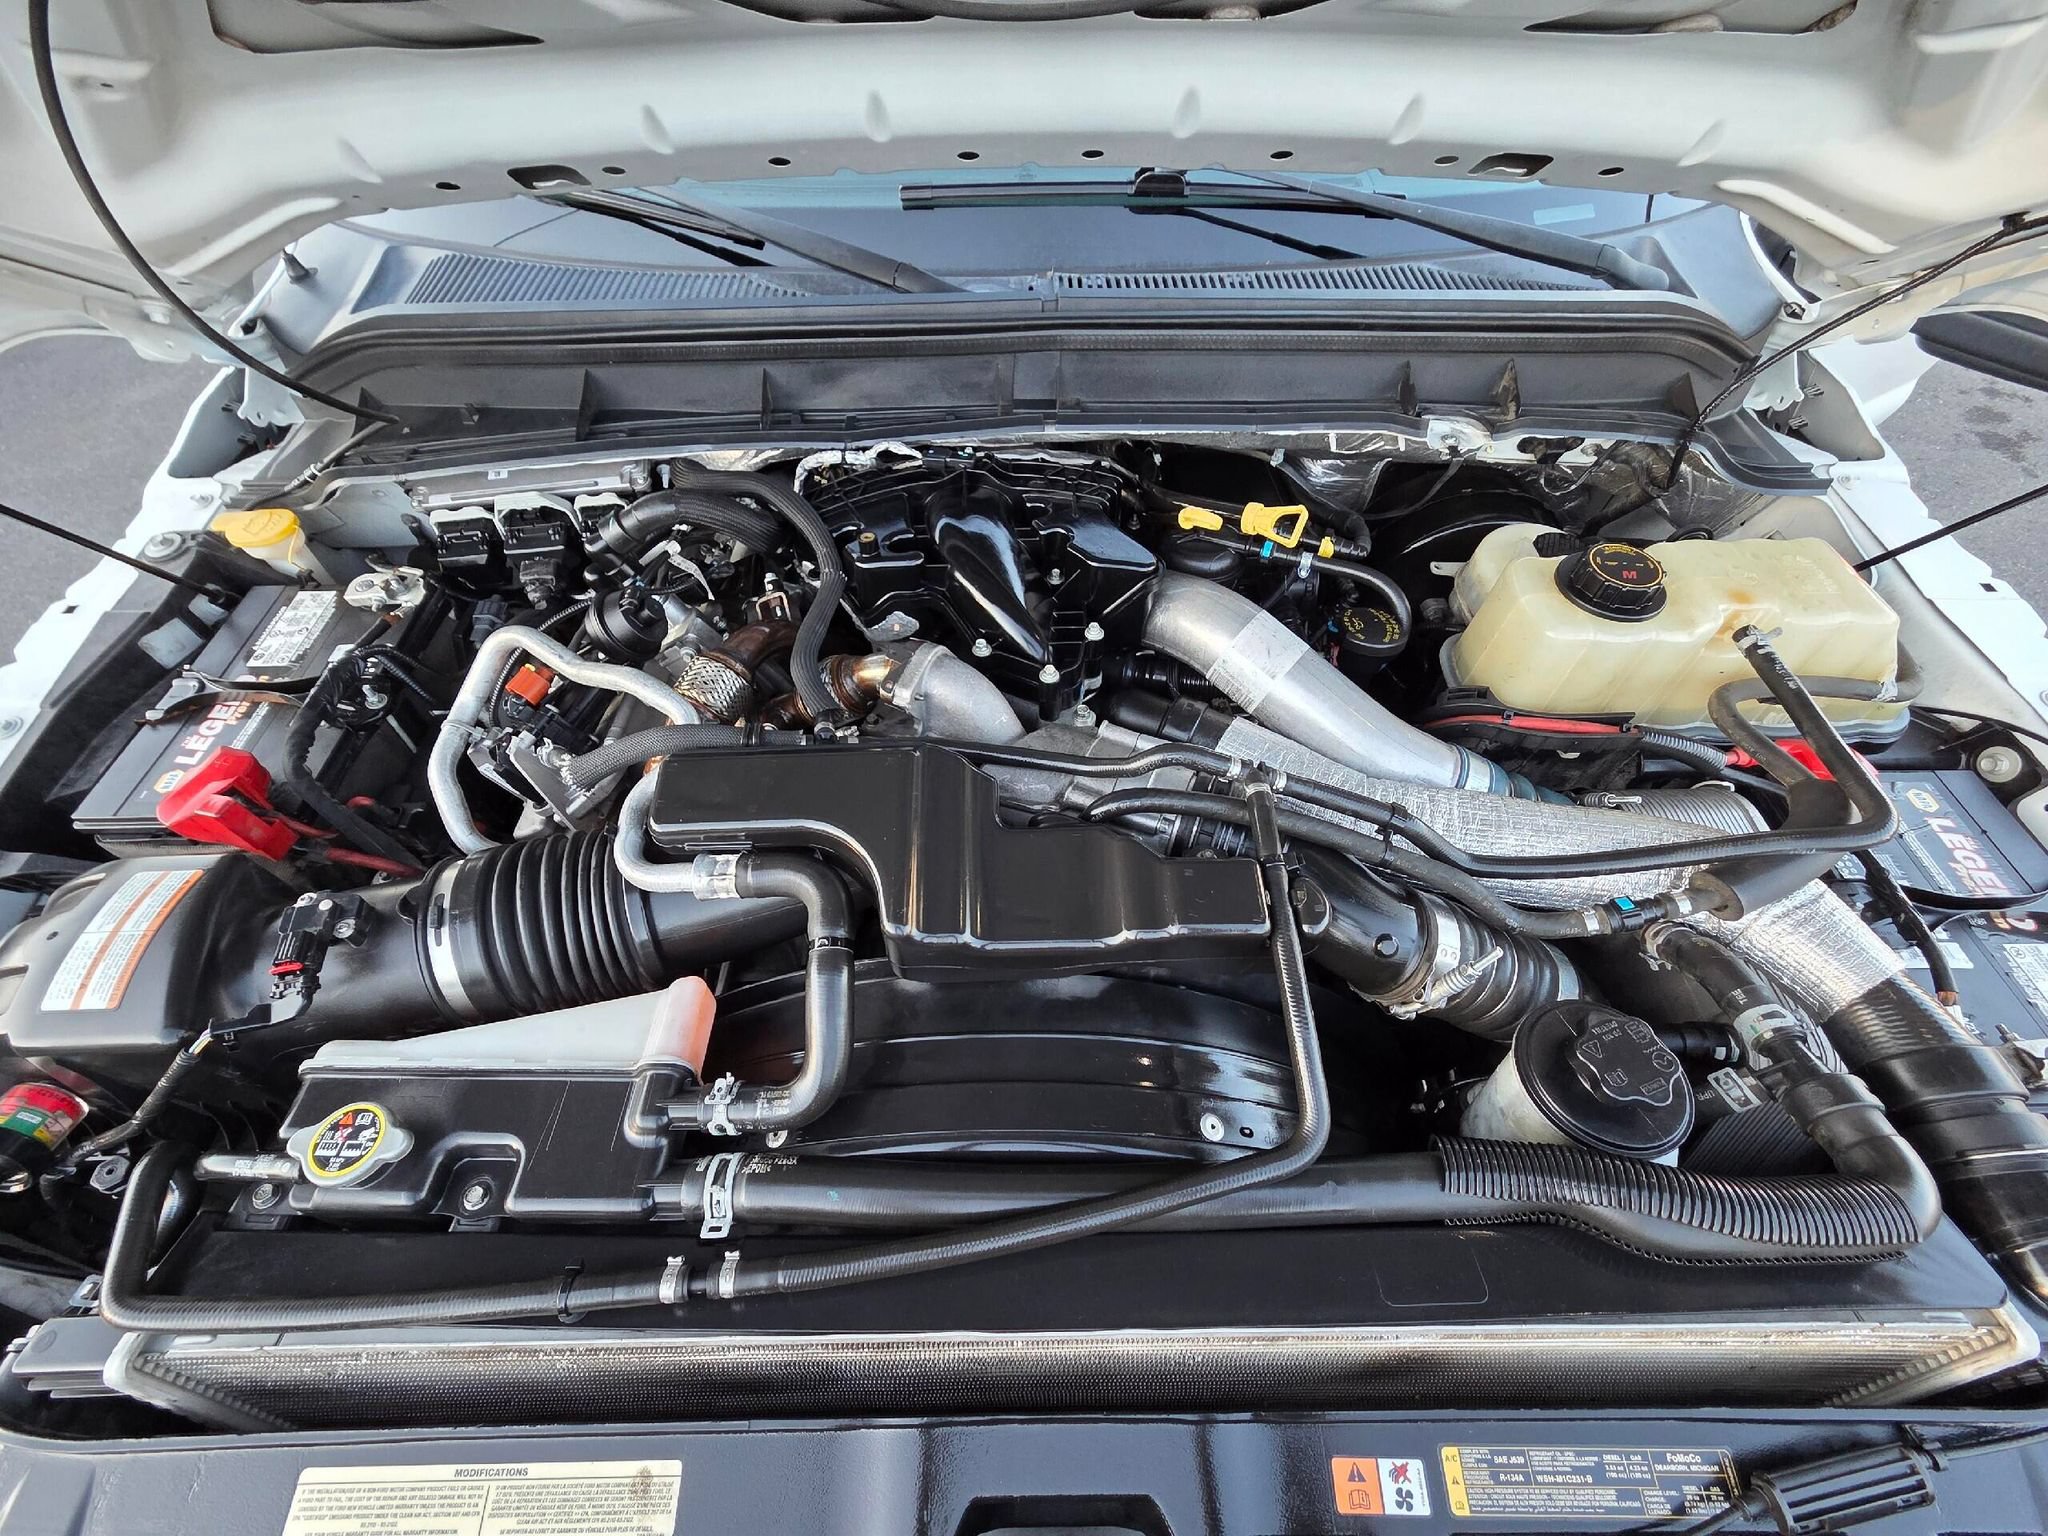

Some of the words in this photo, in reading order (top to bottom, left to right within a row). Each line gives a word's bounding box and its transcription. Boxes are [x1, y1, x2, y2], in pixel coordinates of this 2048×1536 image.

[174, 700, 242, 766] LEGE
[1923, 816, 2012, 896] LEGE
[1445, 1454, 1458, 1462] A/C
[1666, 1453, 1701, 1462] FoMoCo
[454, 1467, 528, 1478] MODIFICATIONS
[1499, 1473, 1524, 1482] R-134A
